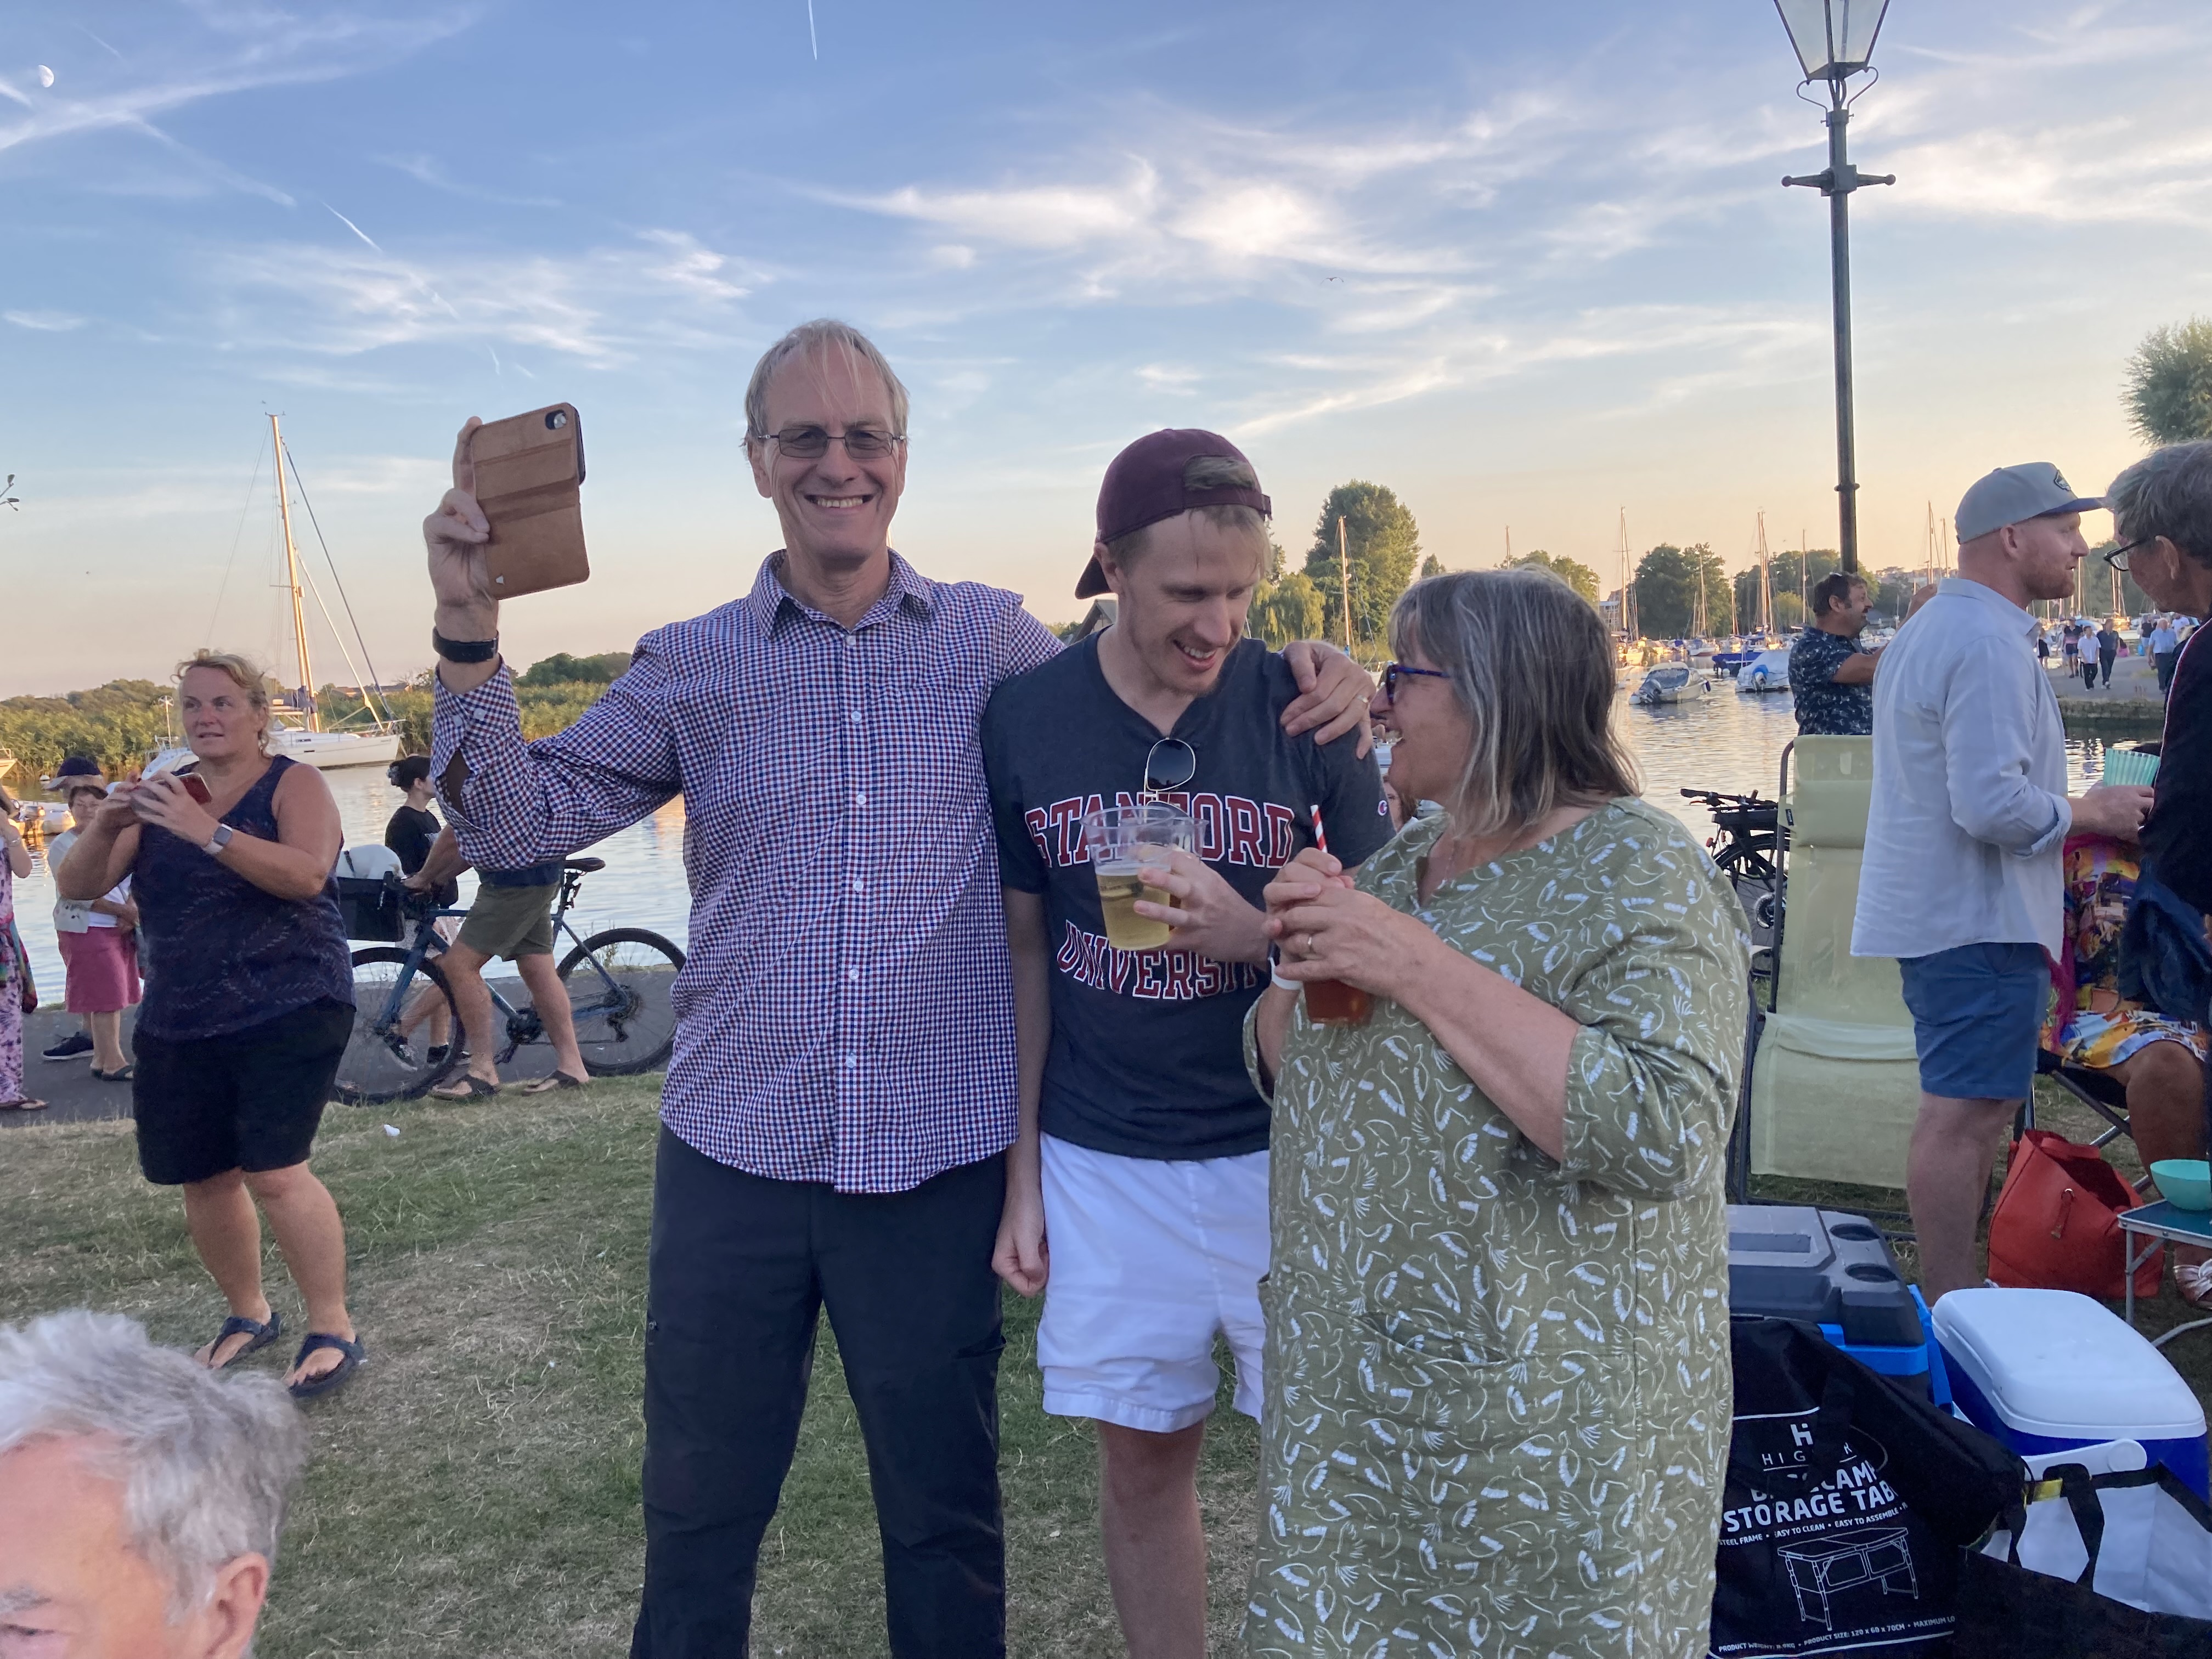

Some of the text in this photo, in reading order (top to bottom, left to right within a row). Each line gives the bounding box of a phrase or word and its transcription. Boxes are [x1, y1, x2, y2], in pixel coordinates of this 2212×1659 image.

[1723, 1480, 1899, 1532] STORAGE TAB
[1740, 1533, 1763, 1545] FRAME
[1803, 1523, 1825, 1533] CLEAN
[1835, 1519, 1853, 1528] EASY
[1854, 1517, 1865, 1526] TO
[1866, 1507, 1899, 1523] ASSEMBLE
[1718, 1643, 1747, 1652] PRODUCT
[1804, 1634, 1832, 1646] PRODUCT
[1886, 1623, 1905, 1632] 70CM
[1913, 1617, 1946, 1628] MAXIMUM
